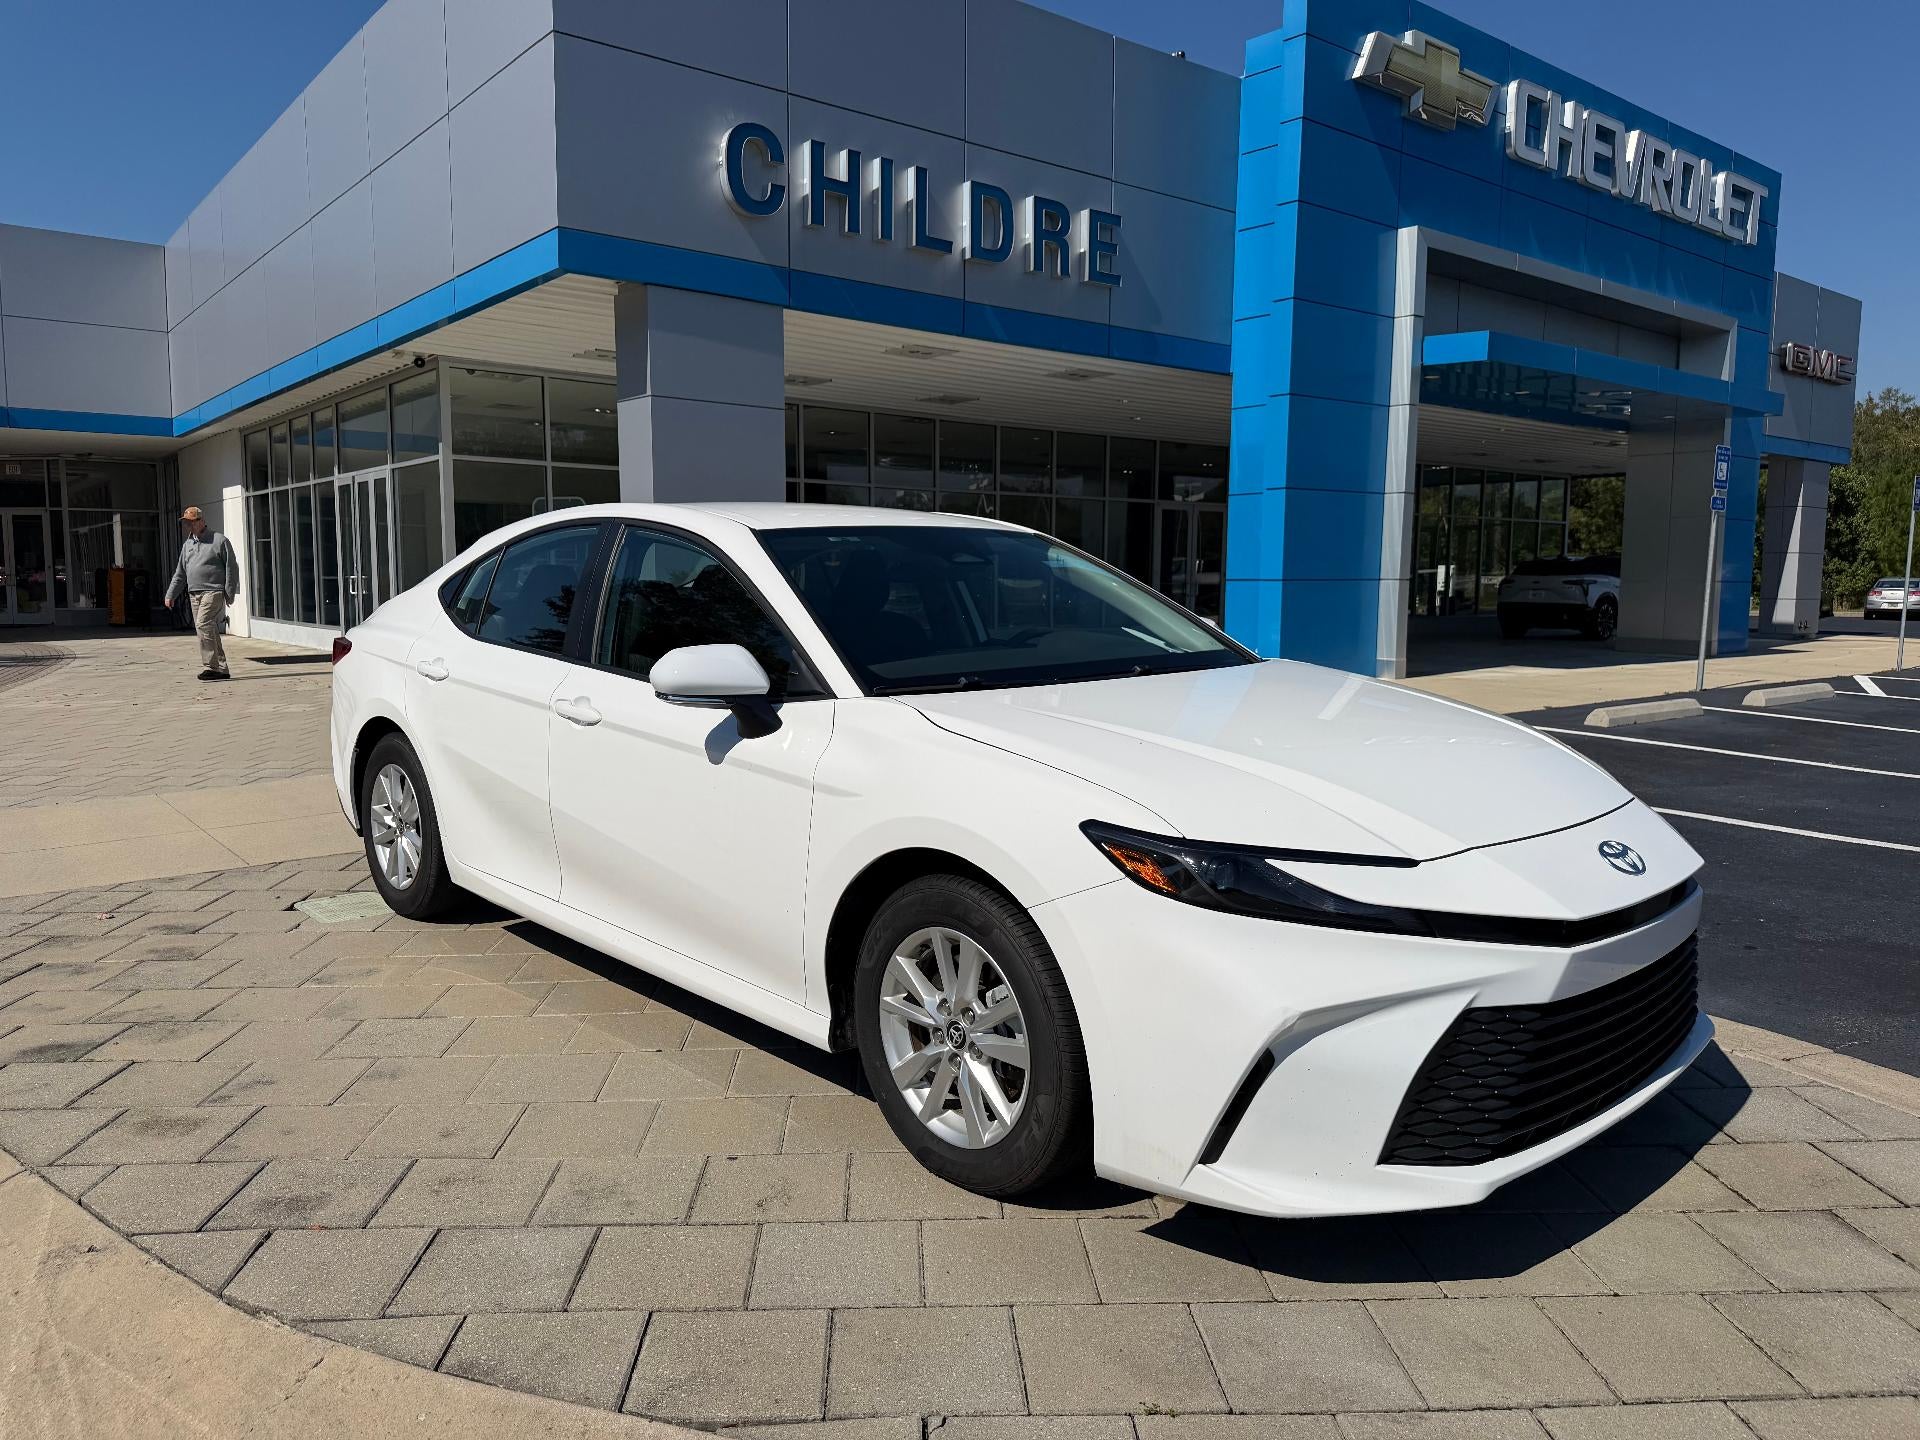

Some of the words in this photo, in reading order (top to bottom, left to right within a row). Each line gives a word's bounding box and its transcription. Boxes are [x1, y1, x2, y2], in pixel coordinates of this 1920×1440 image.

[719, 121, 1123, 288] CHILDRE
[1505, 78, 1769, 246] CHEVROLET
[1785, 342, 1853, 384] GMC
